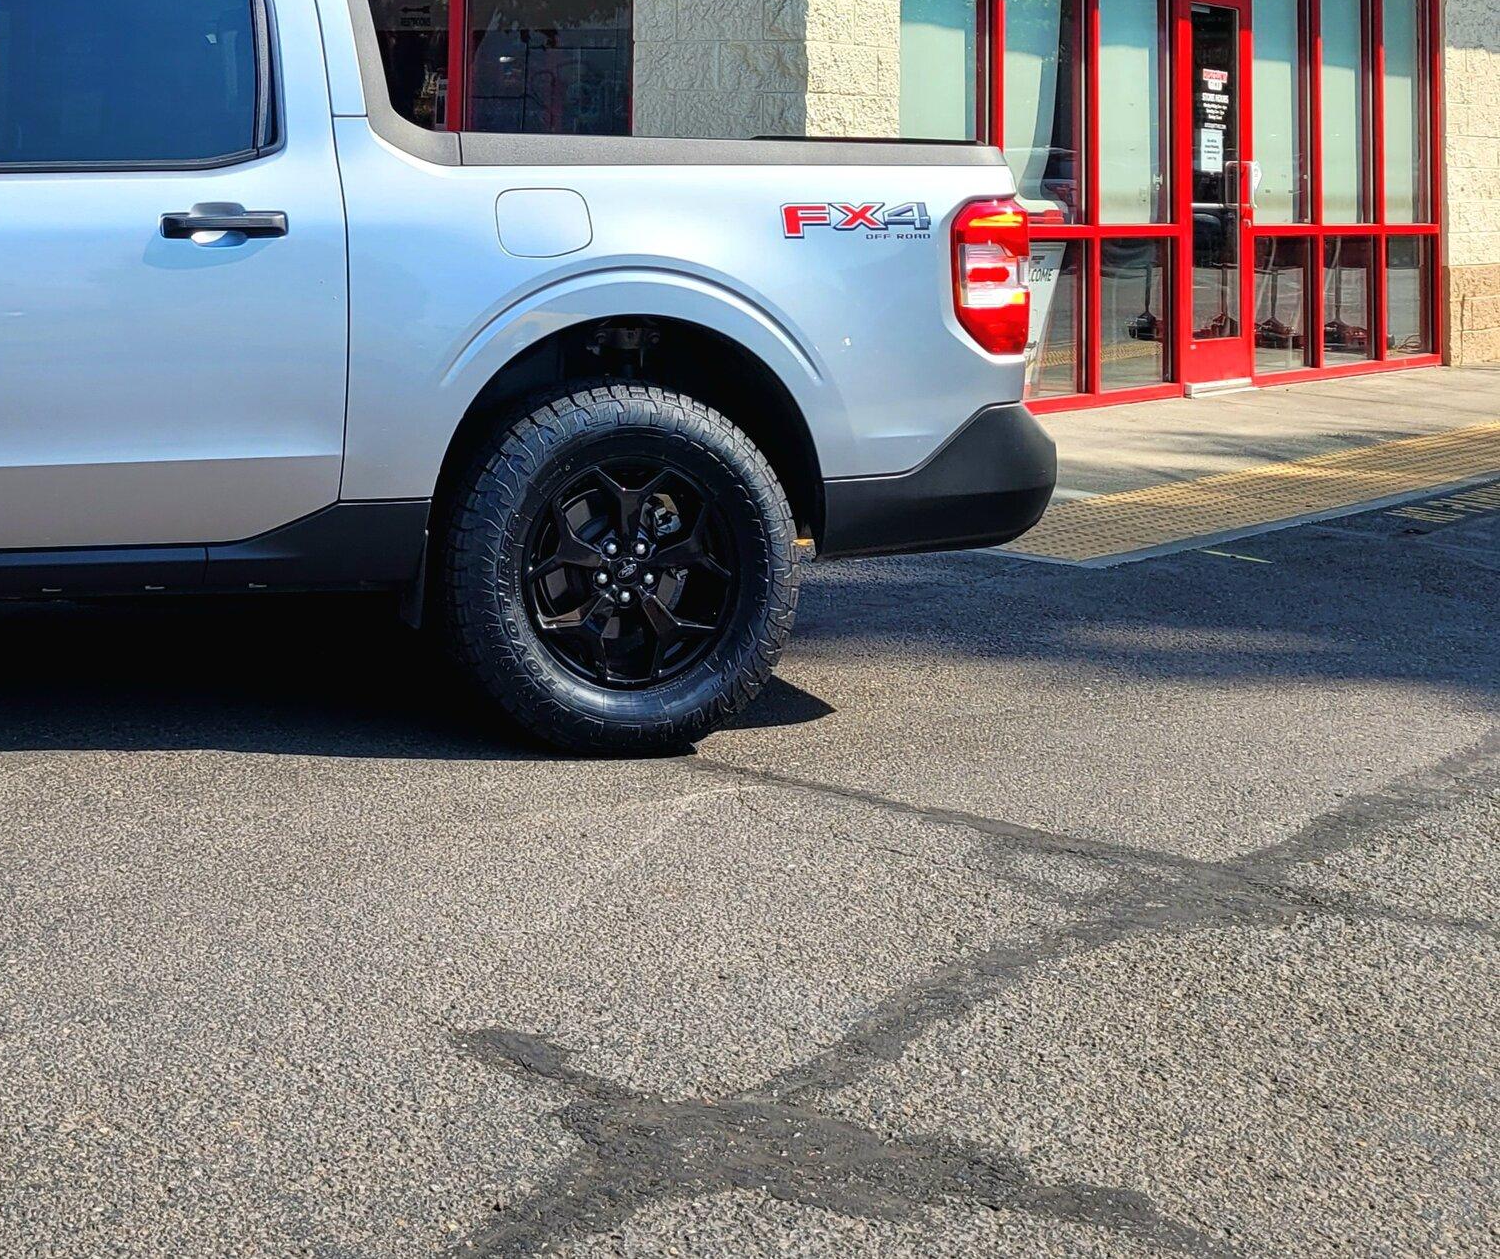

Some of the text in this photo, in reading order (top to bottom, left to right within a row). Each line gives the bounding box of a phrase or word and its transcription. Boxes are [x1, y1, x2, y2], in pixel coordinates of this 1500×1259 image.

[780, 202, 932, 239] FX4
[865, 233, 931, 241] OFF ROAD
